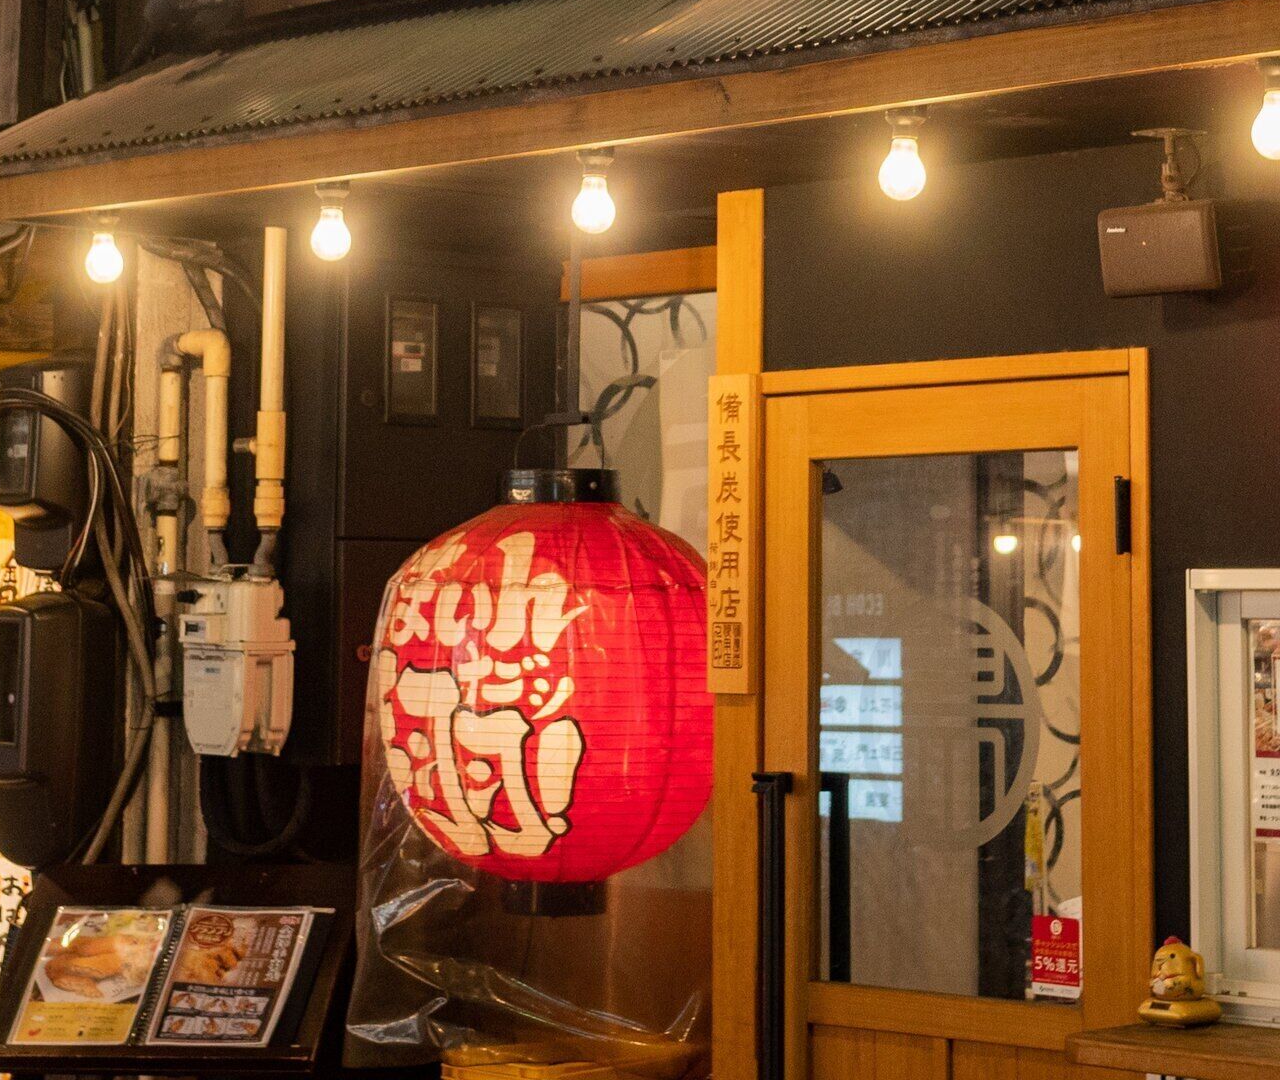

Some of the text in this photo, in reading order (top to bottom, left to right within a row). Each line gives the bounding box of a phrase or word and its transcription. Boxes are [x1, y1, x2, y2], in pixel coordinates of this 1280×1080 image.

[716, 392, 743, 618] 備長炭使用店
[1034, 955, 1079, 975] 5%還元
